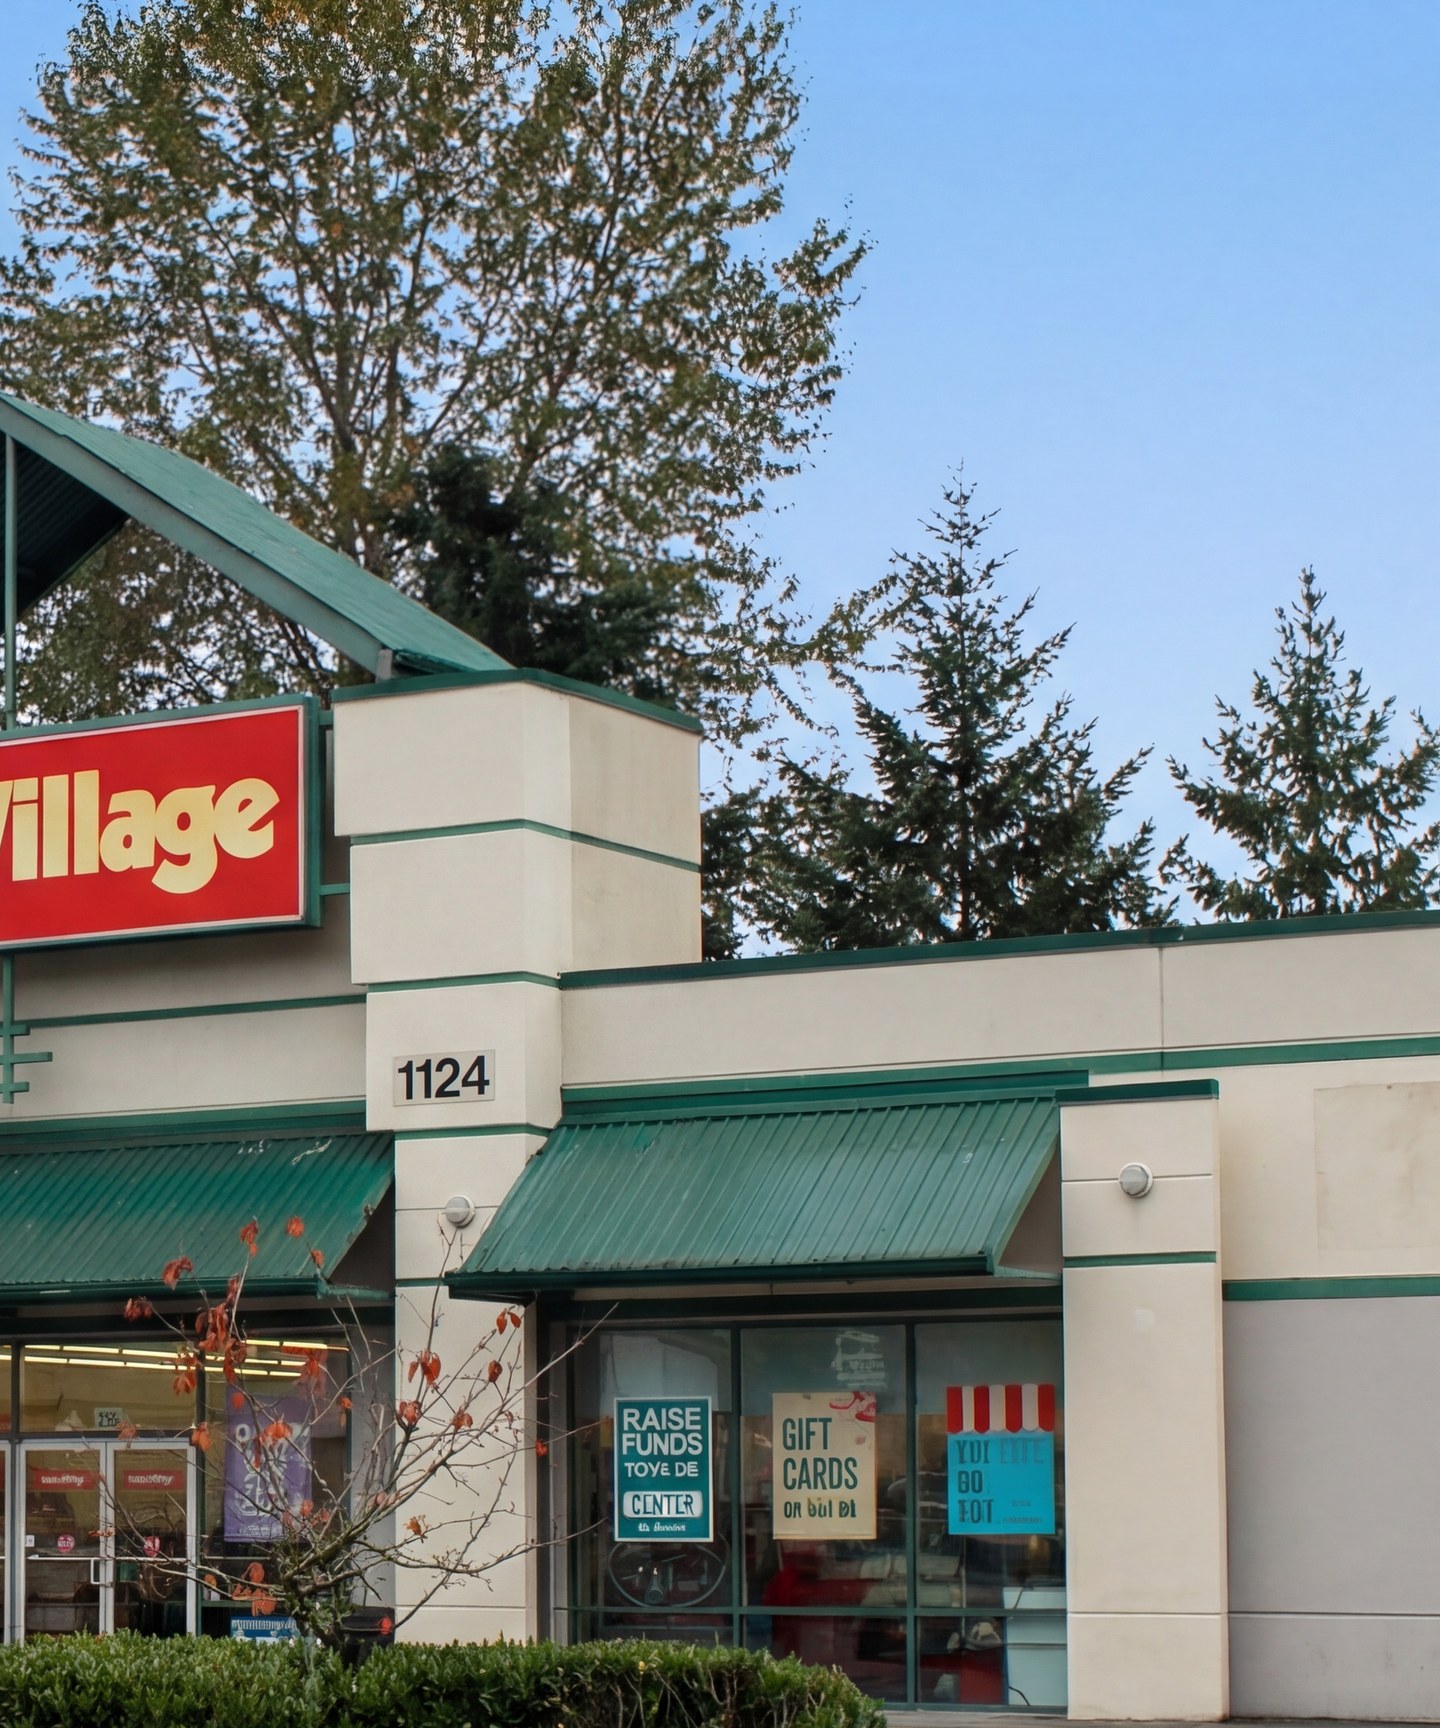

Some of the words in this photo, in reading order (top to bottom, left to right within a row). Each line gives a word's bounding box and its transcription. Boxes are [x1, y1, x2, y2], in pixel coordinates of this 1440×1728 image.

[397, 1055, 490, 1100] 1124
[623, 1407, 701, 1431] RAISE
[622, 1432, 703, 1456] FUNDS
[782, 1417, 833, 1451] GIFT
[782, 1457, 859, 1491] CARDS
[632, 1494, 695, 1516] CENTER
